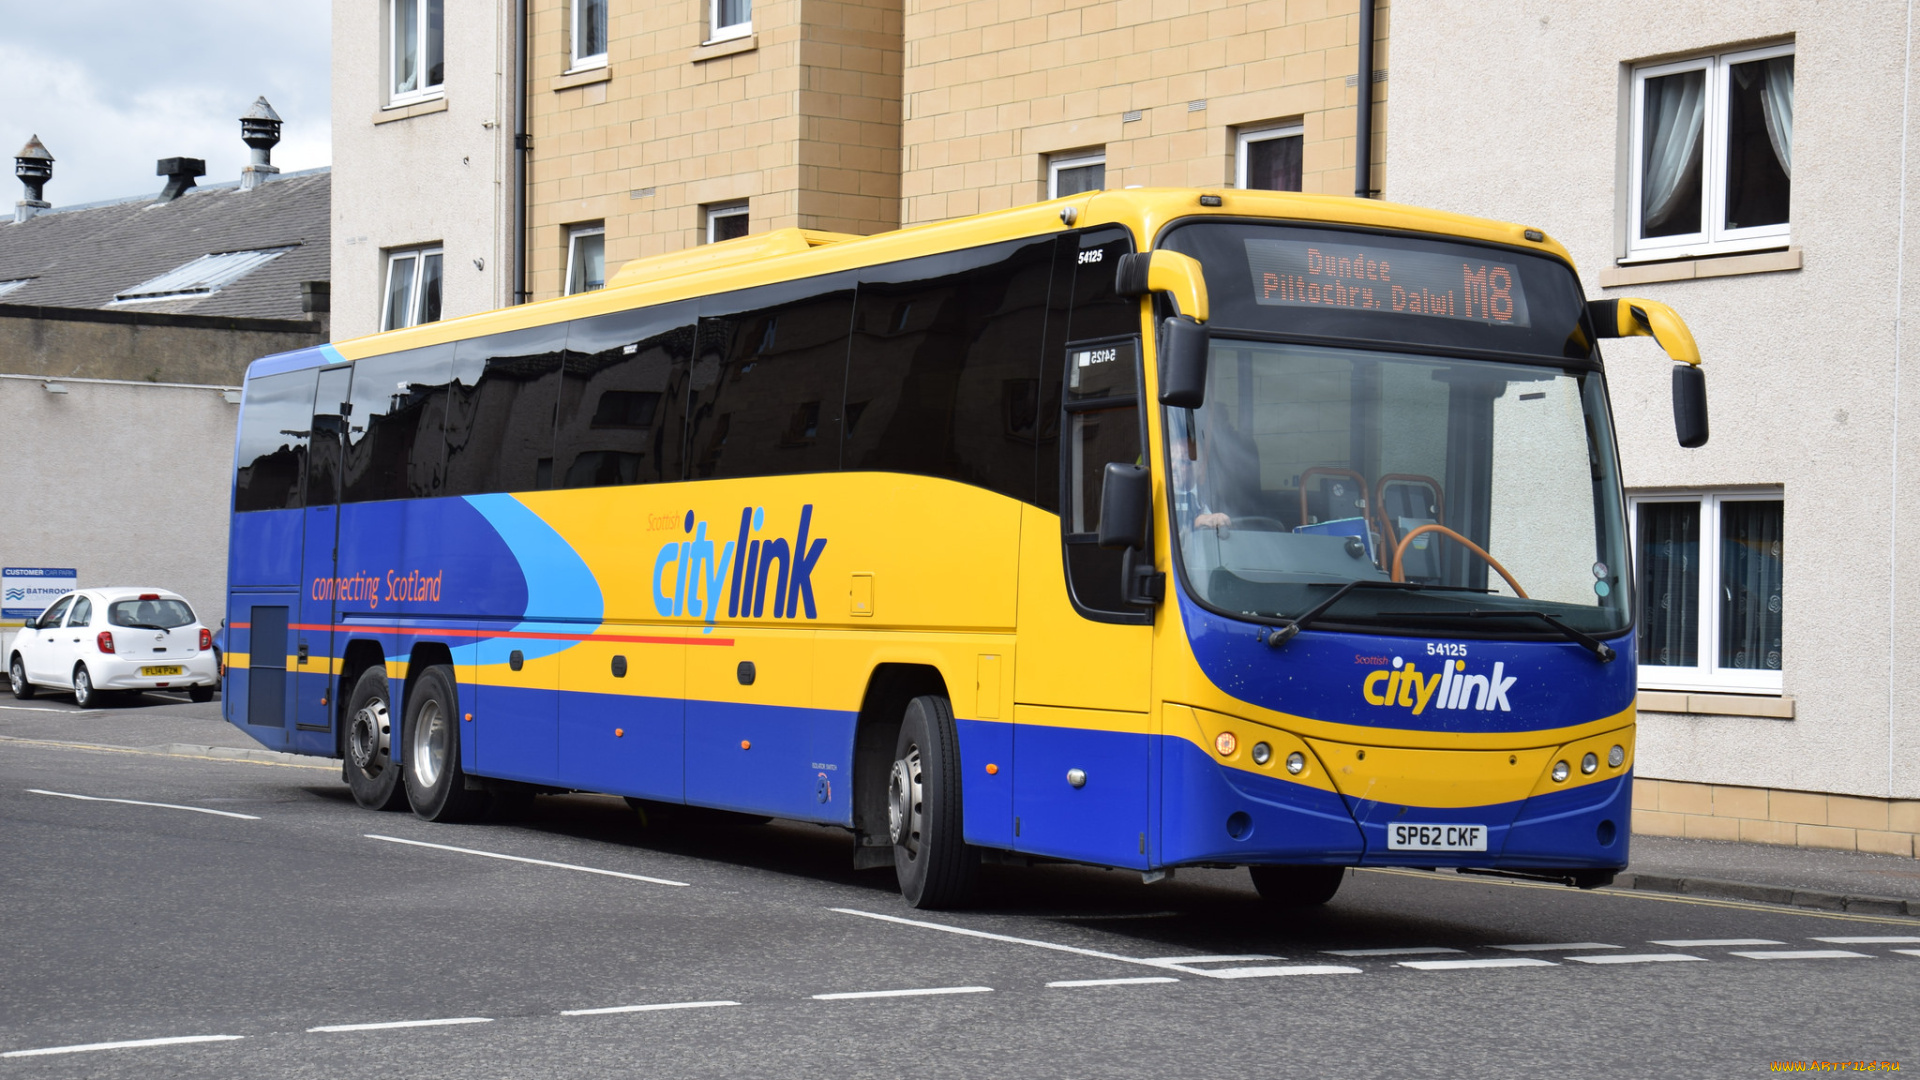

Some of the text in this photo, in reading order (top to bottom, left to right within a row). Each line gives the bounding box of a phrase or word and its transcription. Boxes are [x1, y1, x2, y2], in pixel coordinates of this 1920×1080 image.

[1077, 249, 1103, 264] 54125
[1307, 248, 1391, 281] Dundee
[1462, 264, 1514, 320] M8
[646, 512, 680, 531] Scottish
[652, 504, 828, 635] citylink
[312, 569, 443, 609] connecting Scotland
[1354, 654, 1389, 666] Scottish
[1426, 643, 1468, 657] 54125
[1363, 656, 1518, 716] citylink
[1396, 826, 1480, 846] SP62 CKF
